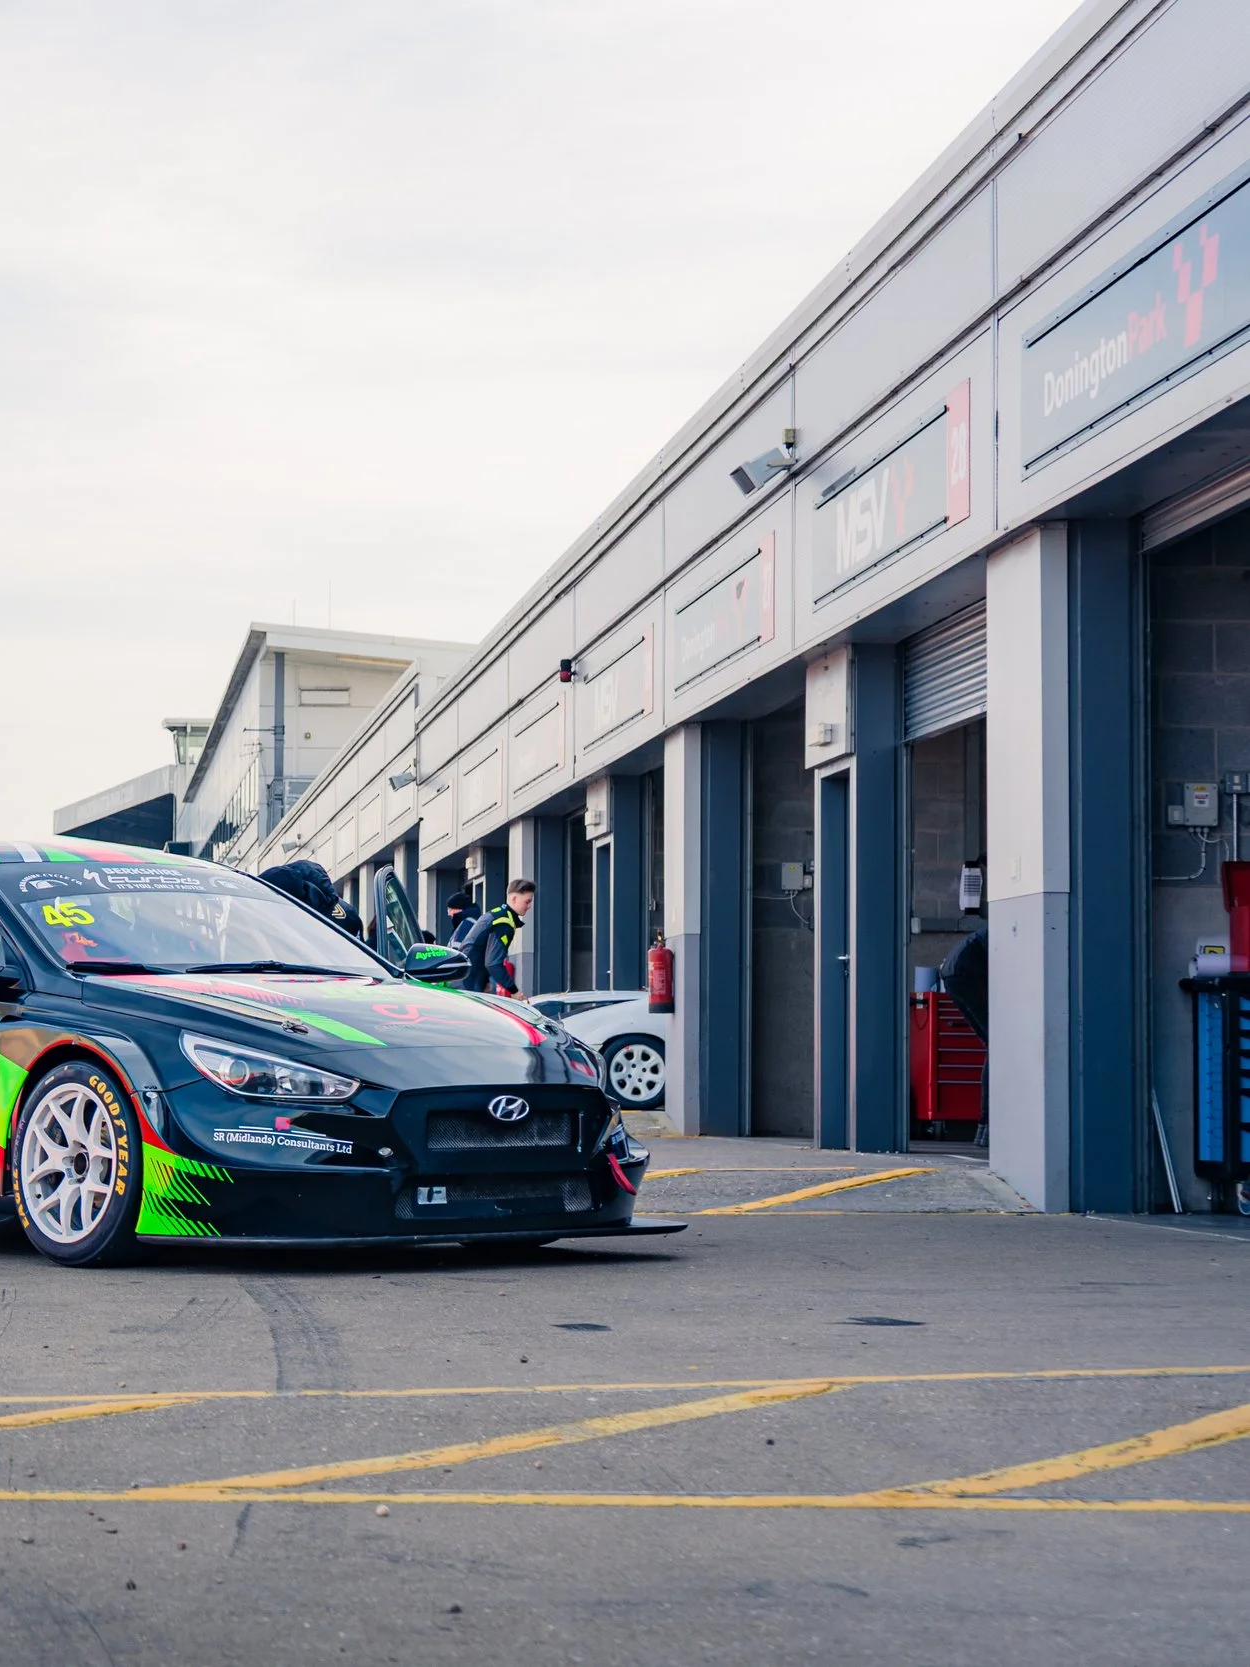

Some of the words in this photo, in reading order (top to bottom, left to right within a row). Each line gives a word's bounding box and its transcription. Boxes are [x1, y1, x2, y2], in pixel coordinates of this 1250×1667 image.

[1044, 291, 1167, 417] DoningtonPark
[952, 421, 967, 485] 28
[836, 467, 889, 574] MSV
[101, 868, 182, 876] BERKSHIRE
[42, 902, 95, 927] 45
[213, 1132, 225, 1142] SR
[226, 1133, 276, 1146] (Midlands)
[277, 1137, 334, 1152] Consultants
[336, 1143, 352, 1154] Ltd
